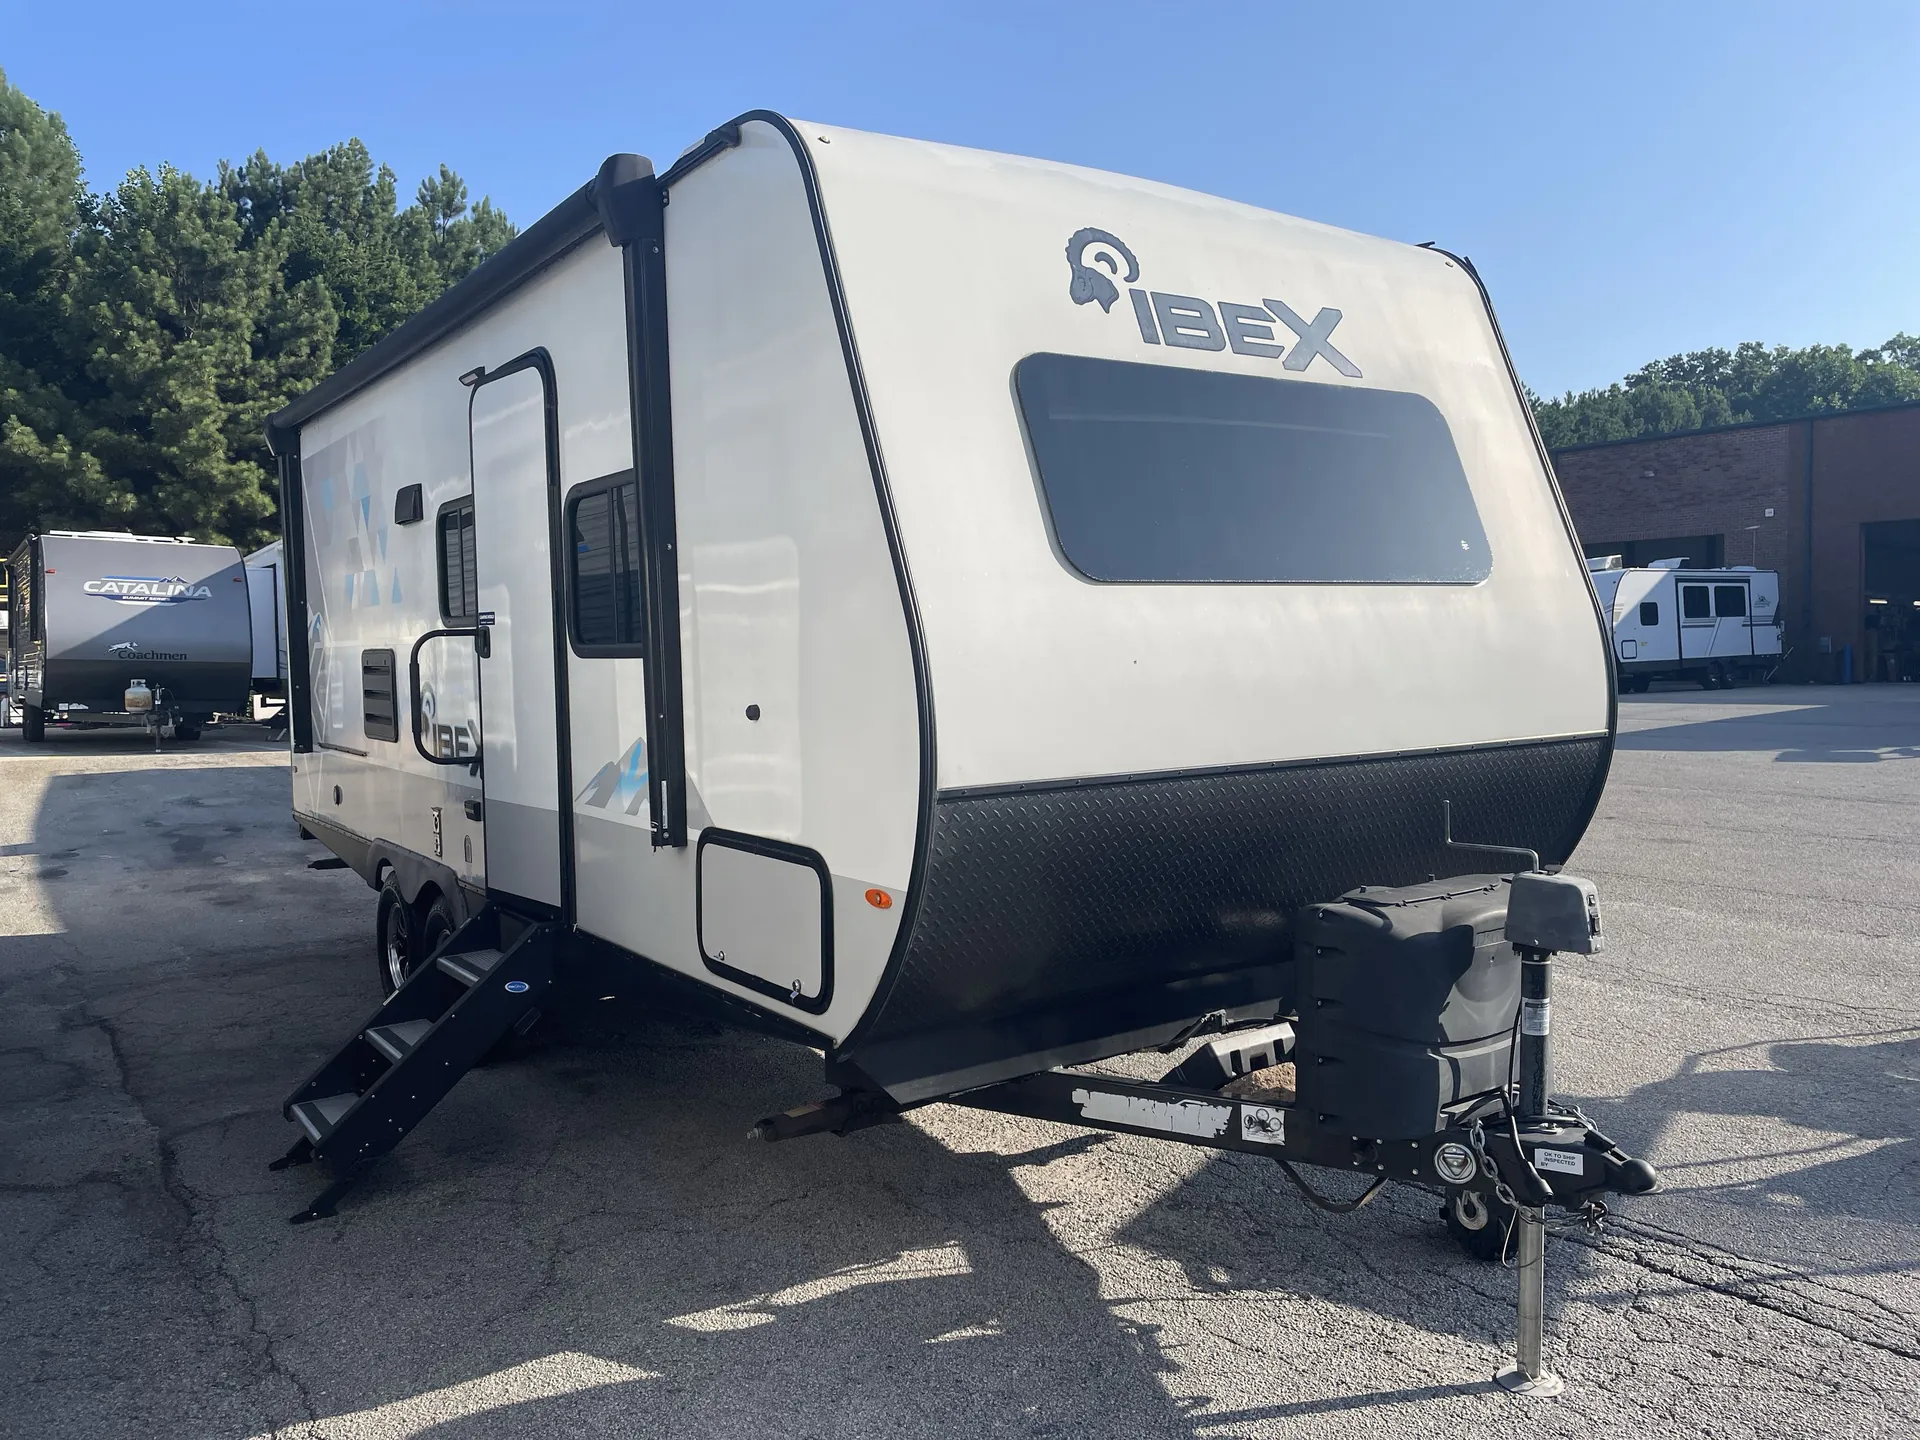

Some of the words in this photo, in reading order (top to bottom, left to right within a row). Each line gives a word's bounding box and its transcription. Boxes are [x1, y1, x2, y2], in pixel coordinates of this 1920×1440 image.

[1128, 288, 1363, 378] IBEX
[83, 580, 212, 598] CATALINA
[118, 650, 187, 660] Coachmen
[1544, 1157, 1576, 1166] INSPECTED
